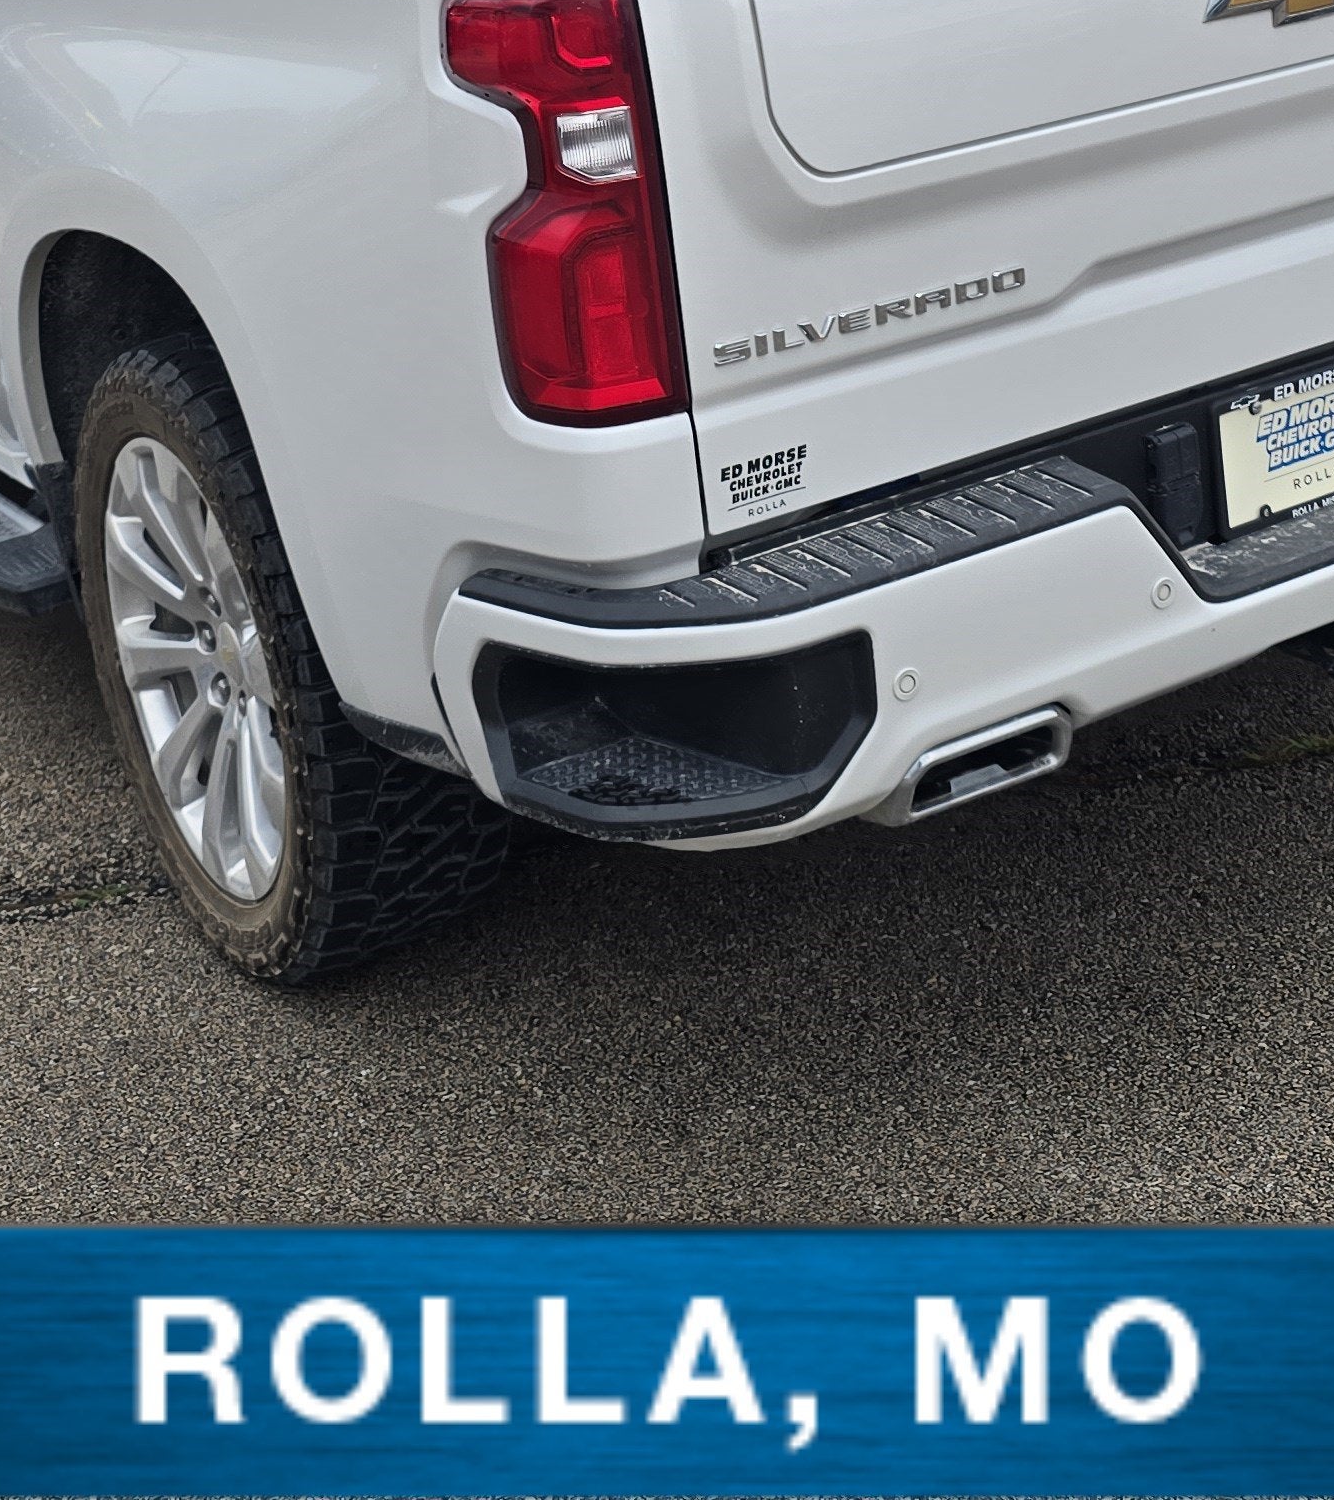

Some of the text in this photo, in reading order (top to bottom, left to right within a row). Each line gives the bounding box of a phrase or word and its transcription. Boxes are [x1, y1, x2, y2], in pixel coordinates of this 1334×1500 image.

[713, 266, 1027, 368] SILVERADO
[1273, 382, 1295, 402] ED
[1257, 408, 1290, 443] ED
[720, 444, 808, 483] ED MORSE
[729, 460, 803, 493] CHEVROLET
[748, 499, 787, 518] ROLLA
[1292, 501, 1319, 519] ROLLA
